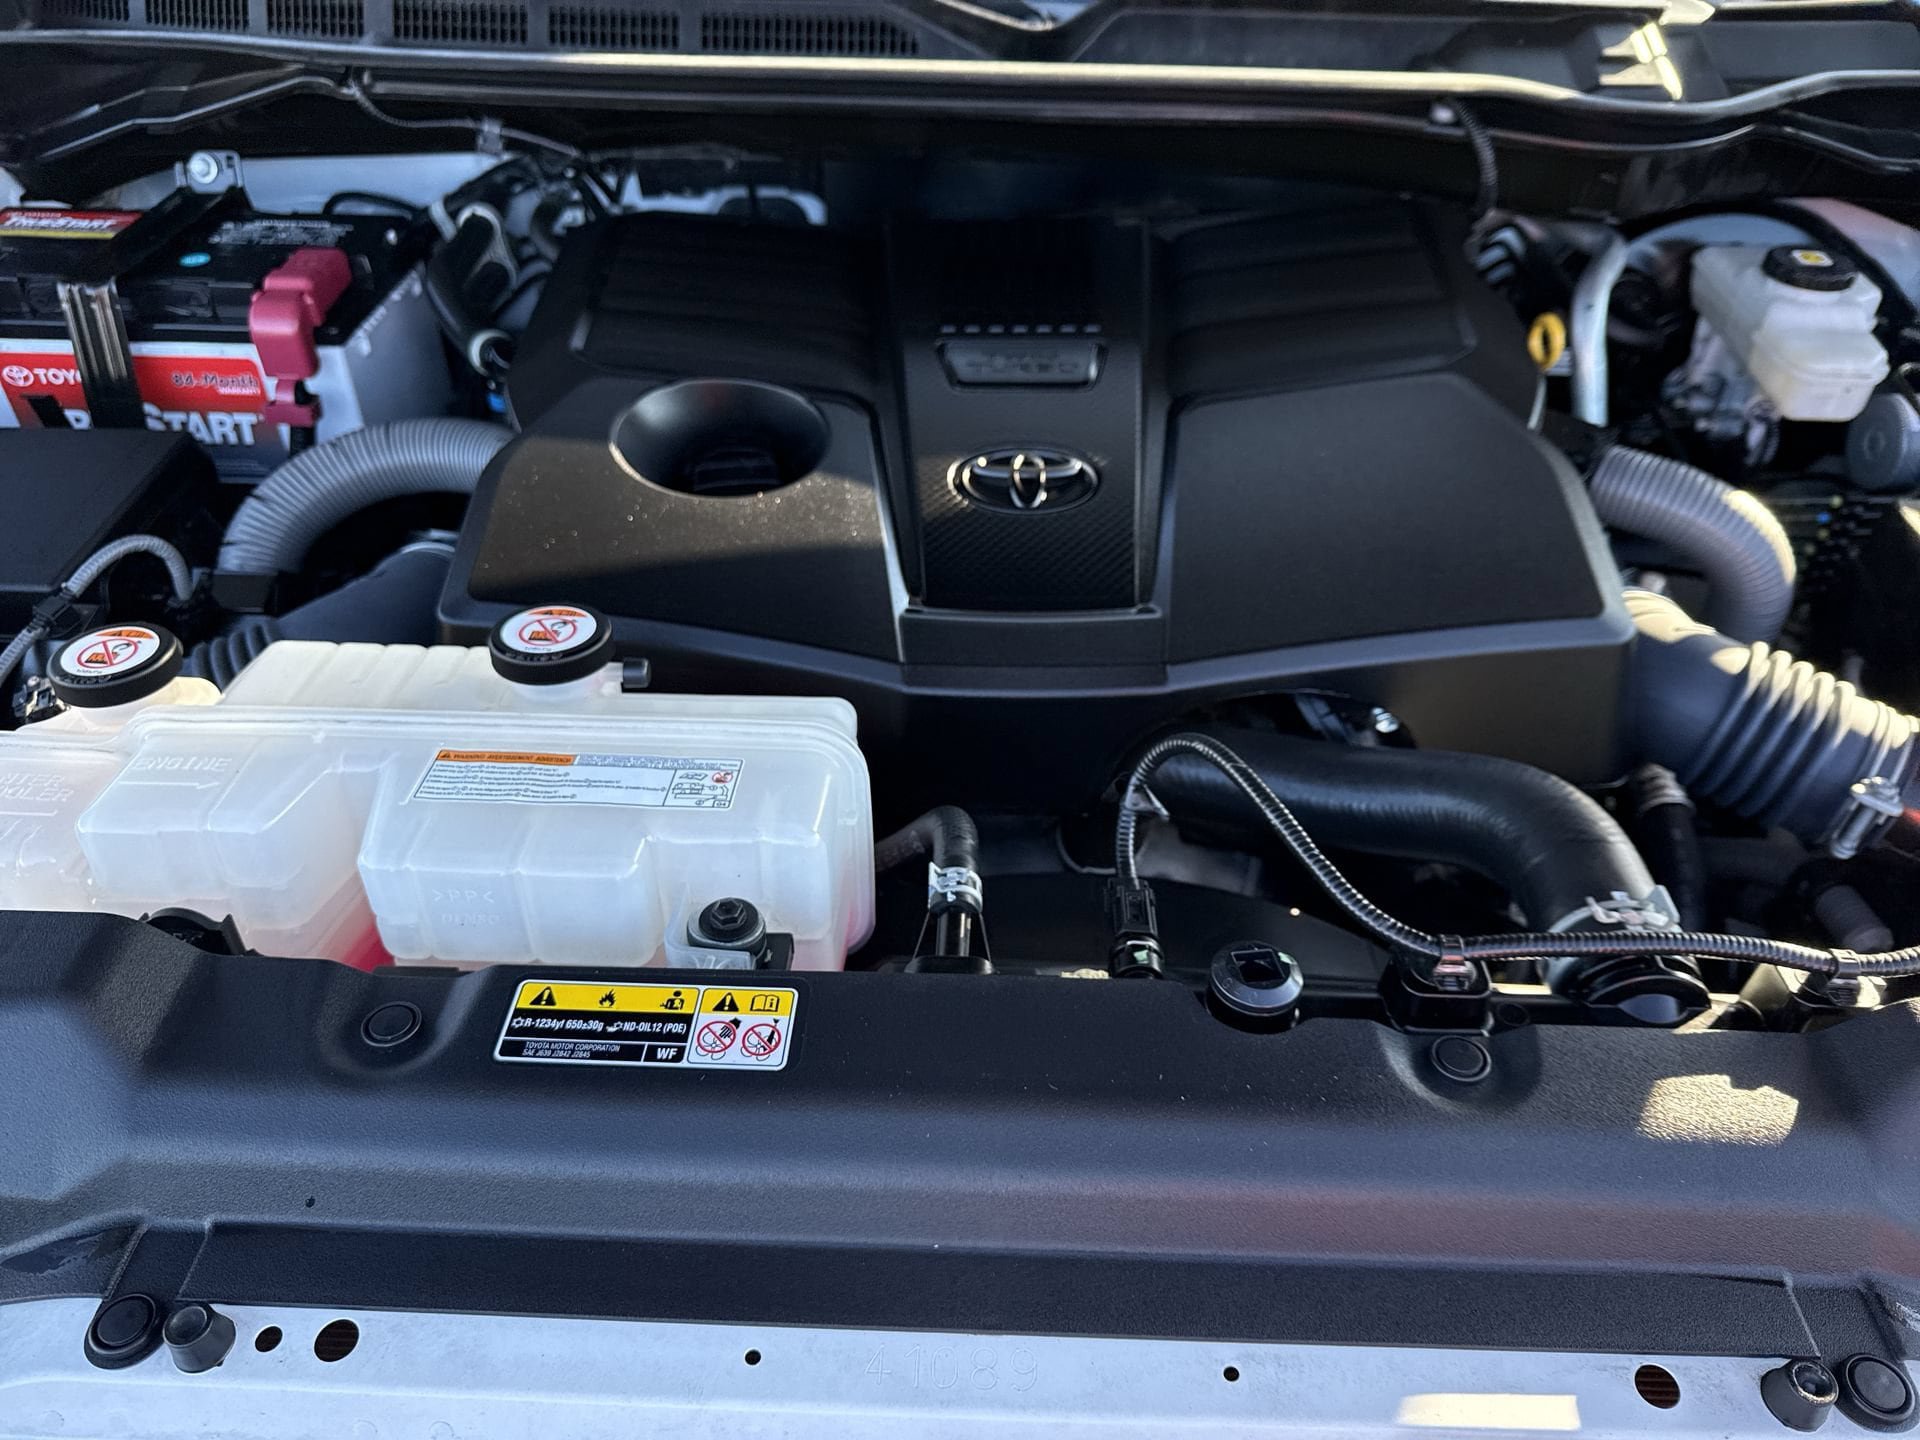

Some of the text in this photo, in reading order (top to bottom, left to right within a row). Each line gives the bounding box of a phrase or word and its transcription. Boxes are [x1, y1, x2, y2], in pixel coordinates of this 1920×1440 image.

[136, 756, 233, 772] ENGINE
[524, 1017, 565, 1031] R-1234yf
[565, 1019, 604, 1032] 650±30g
[663, 1023, 687, 1034] (POE)
[525, 1041, 621, 1052] TOYOTA MOTOR CORPORATION
[656, 1047, 678, 1060] WF
[863, 1343, 1039, 1393] 41089
